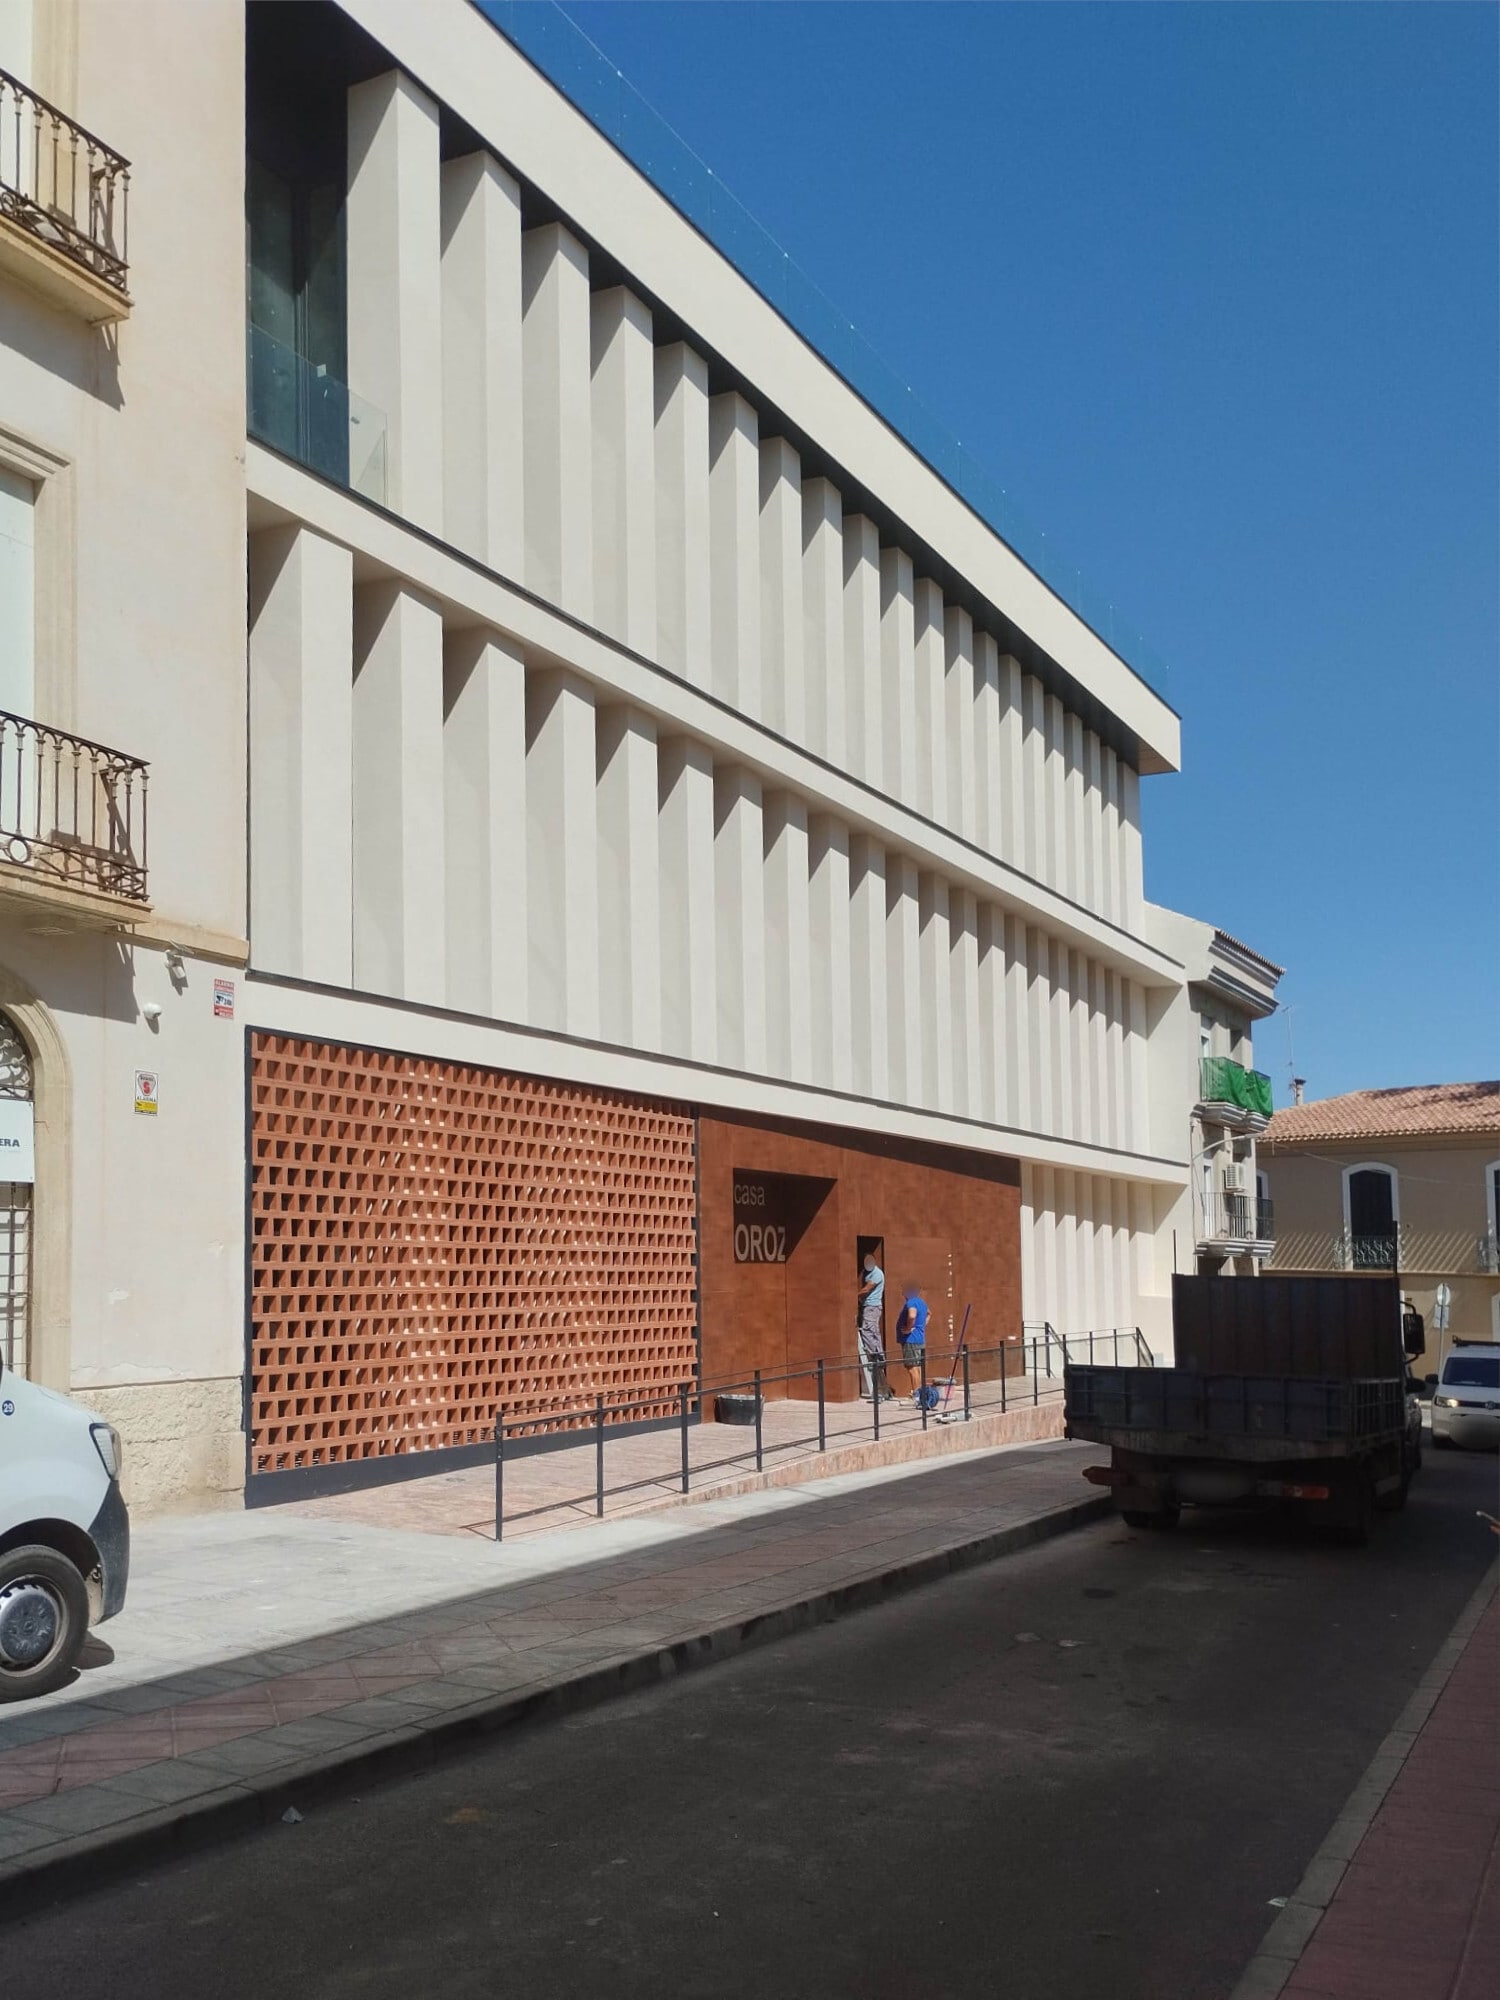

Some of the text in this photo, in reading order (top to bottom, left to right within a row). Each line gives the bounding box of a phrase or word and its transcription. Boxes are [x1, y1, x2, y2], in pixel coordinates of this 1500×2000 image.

[735, 1184, 765, 1206] casa
[735, 1224, 785, 1261] OROZ
[3, 1402, 13, 1412] 29
